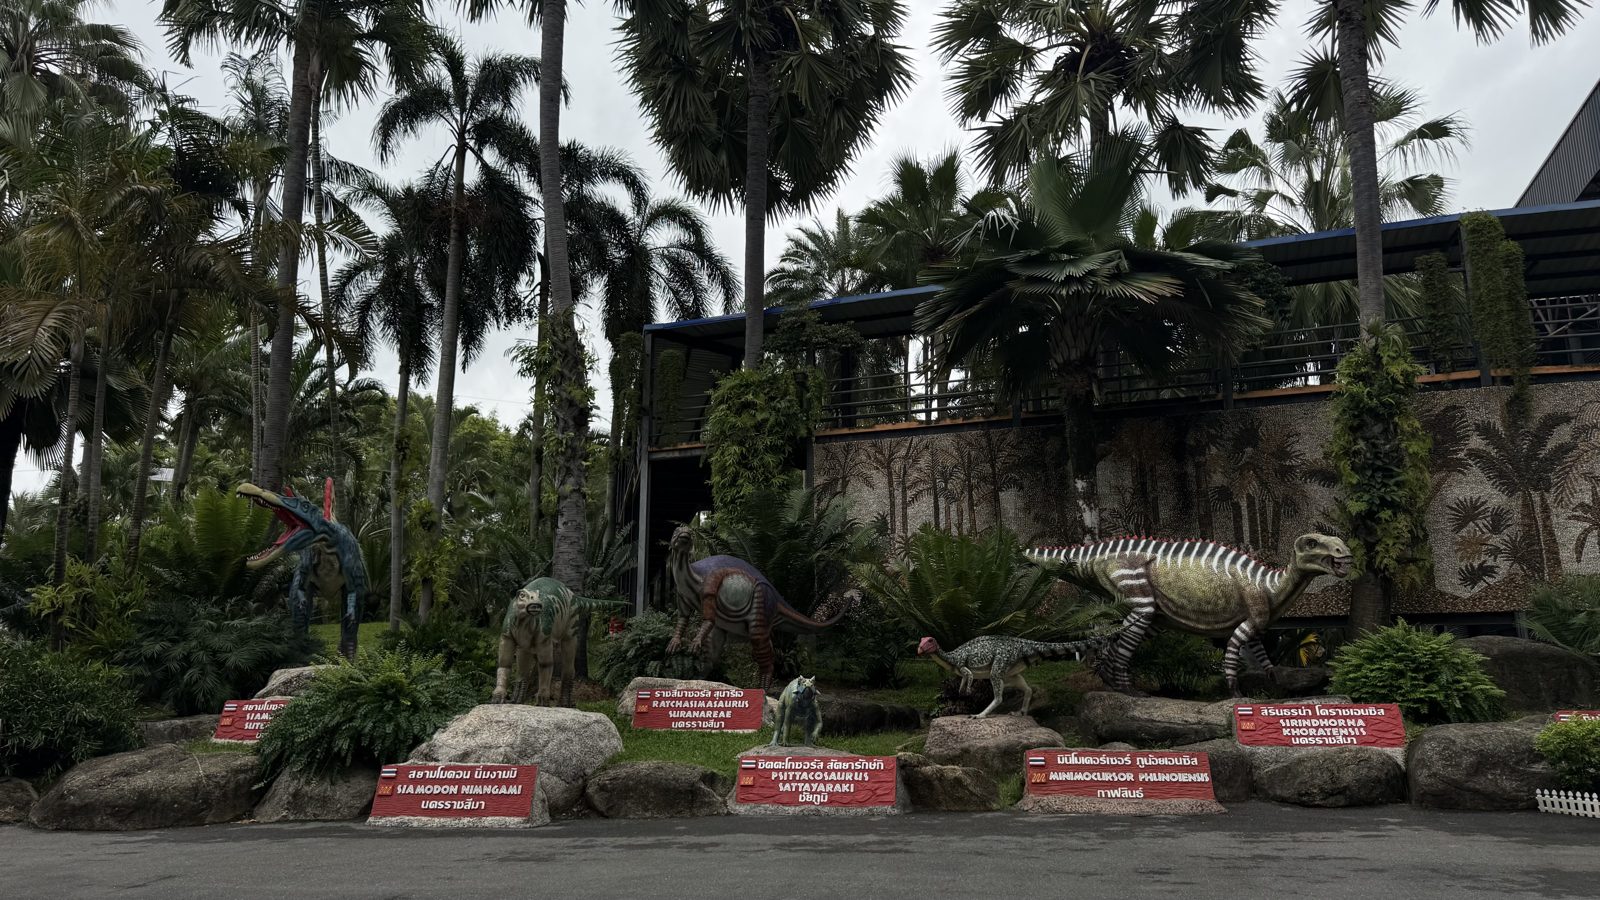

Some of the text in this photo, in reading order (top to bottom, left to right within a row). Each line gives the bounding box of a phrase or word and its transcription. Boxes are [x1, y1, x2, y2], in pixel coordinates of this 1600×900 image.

[653, 700, 748, 708] RATCHASIMASAURUS
[668, 710, 732, 718] SURANAREAE
[672, 719, 724, 728] นครราชสีมา
[1280, 719, 1365, 727] SIRINDHORNA
[1283, 728, 1366, 736] KHORATENSIS
[1292, 735, 1357, 744] นครราชสีมา
[772, 771, 868, 781] PSITTACOSAURUS
[1049, 772, 1209, 782] MINIMOCURSOR PHUNOIENSIS
[397, 785, 523, 795] SIAMODON NIMNGAMI
[779, 783, 854, 793] SATTAYARAKI
[421, 798, 485, 809] นครราชสีมา
[799, 793, 828, 805] ชัยภูมิ
